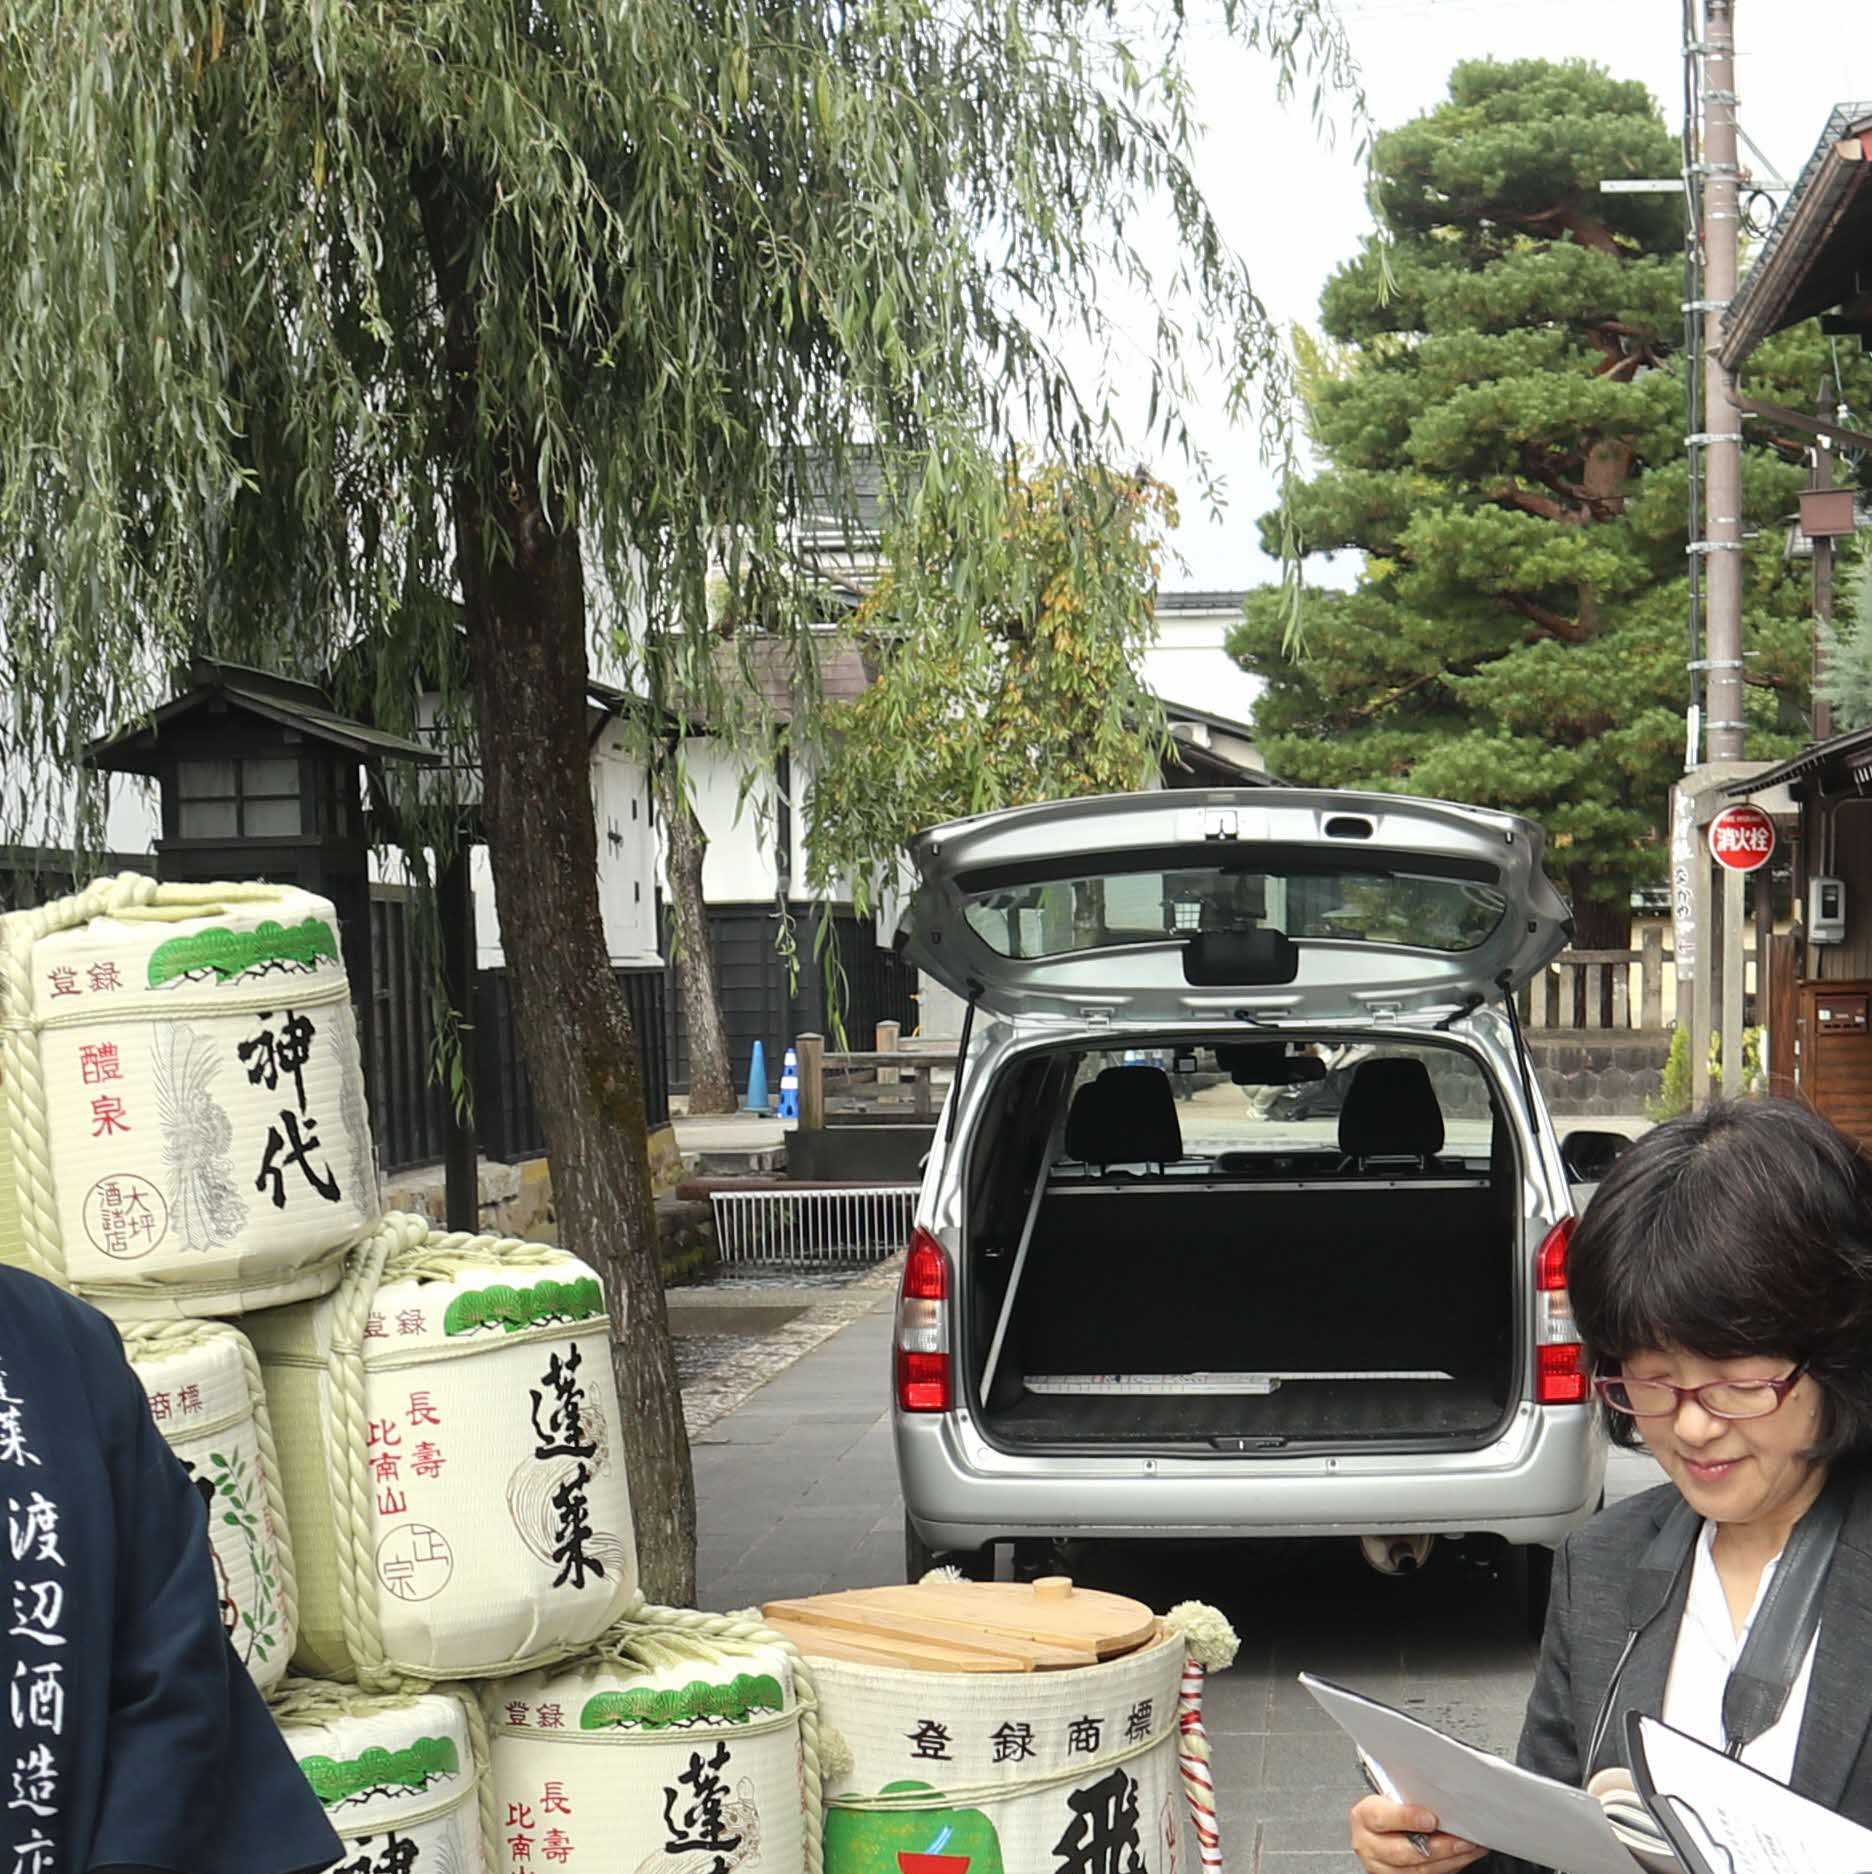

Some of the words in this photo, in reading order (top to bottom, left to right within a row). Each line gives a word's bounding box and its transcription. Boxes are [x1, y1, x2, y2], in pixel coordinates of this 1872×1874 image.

[1716, 826, 1769, 852] 消火栓
[48, 961, 124, 998] 登録
[237, 1009, 341, 1210] 神代
[125, 1185, 157, 1244] 大坪
[902, 1698, 1154, 1764] 登録商標
